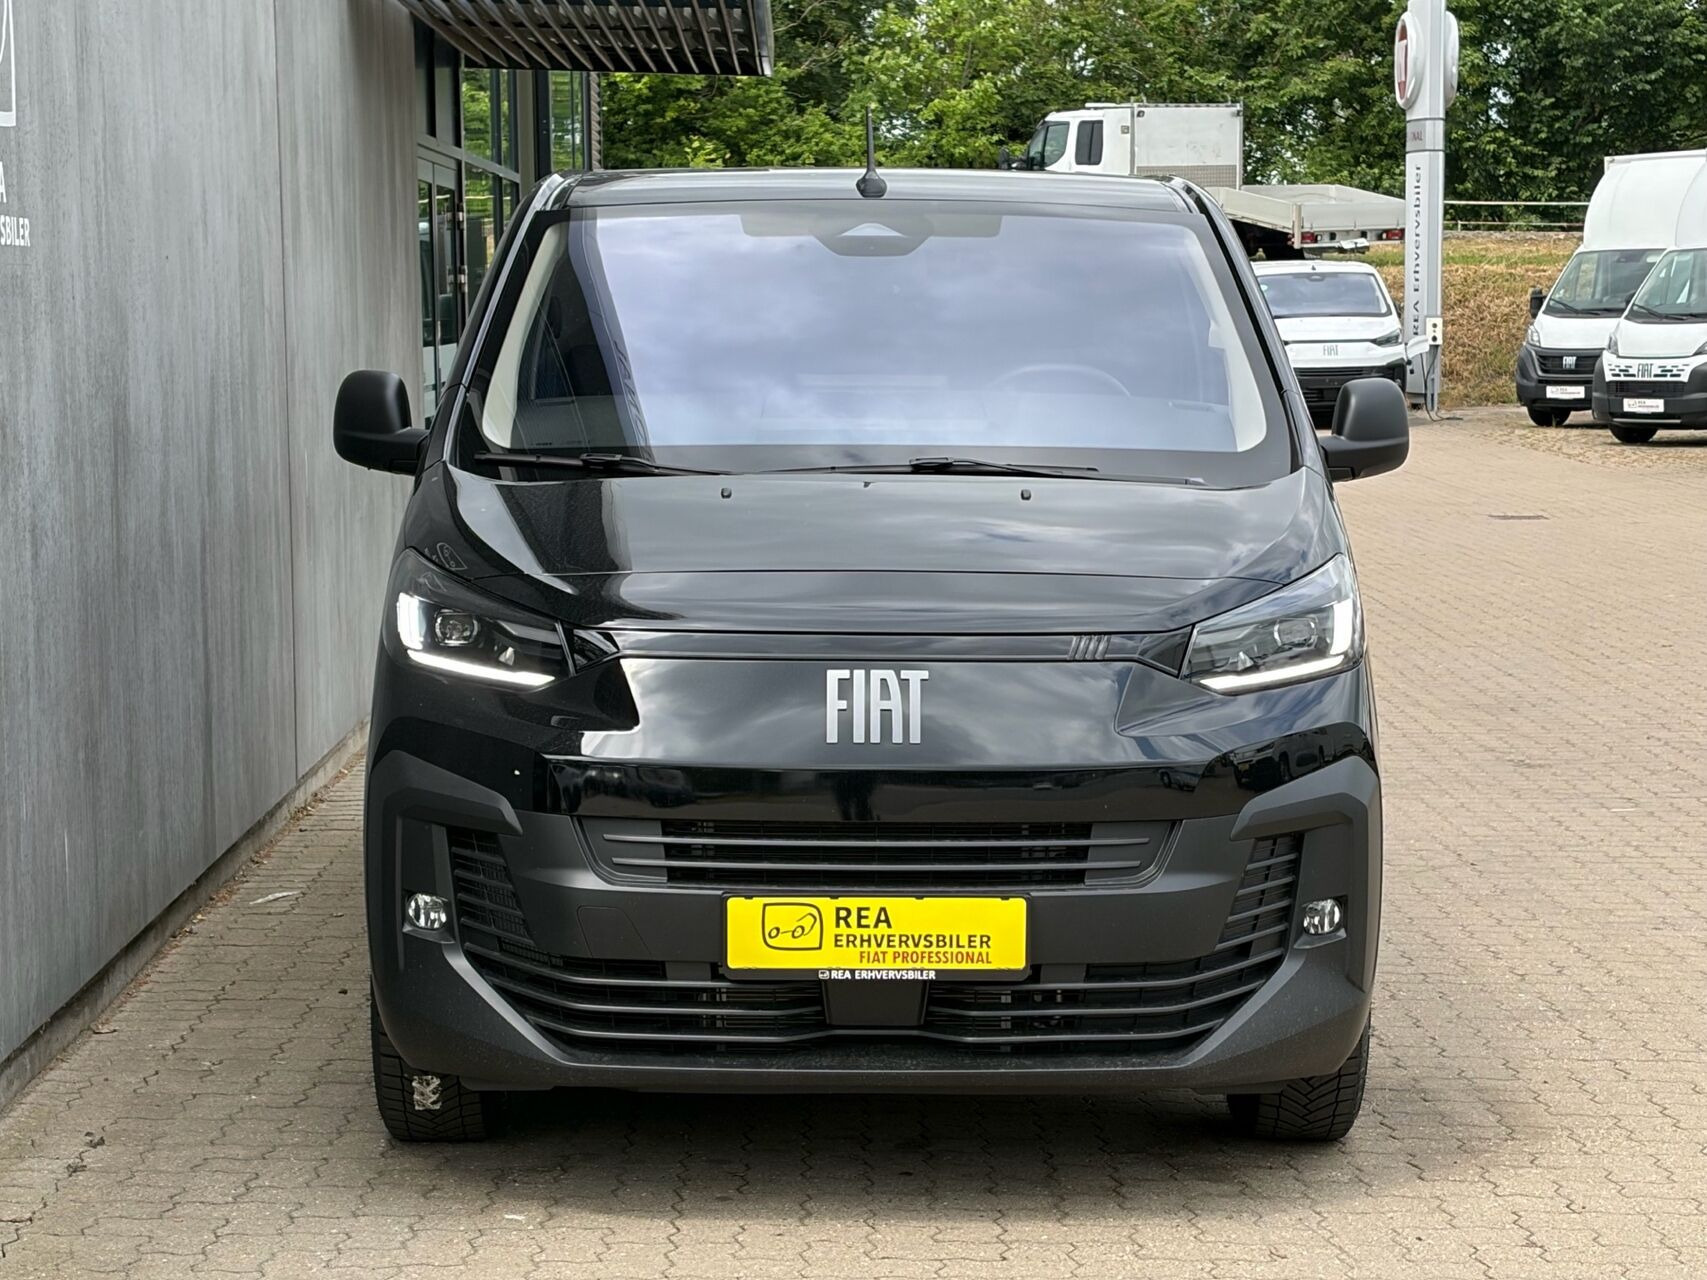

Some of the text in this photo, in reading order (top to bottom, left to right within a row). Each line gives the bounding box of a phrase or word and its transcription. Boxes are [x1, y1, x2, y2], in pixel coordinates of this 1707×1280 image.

[1413, 165, 1422, 293] Erhvervsbiler
[1322, 344, 1339, 356] FIAT
[1562, 356, 1577, 369] FIAT
[1637, 363, 1653, 378] FIAT
[826, 669, 929, 744] FIAT
[835, 906, 892, 929] REA
[834, 933, 991, 949] ERHVERVSBILER
[859, 951, 992, 964] FIAT PROFESSIONAL
[831, 970, 936, 980] REA ERHVERVSBILER
